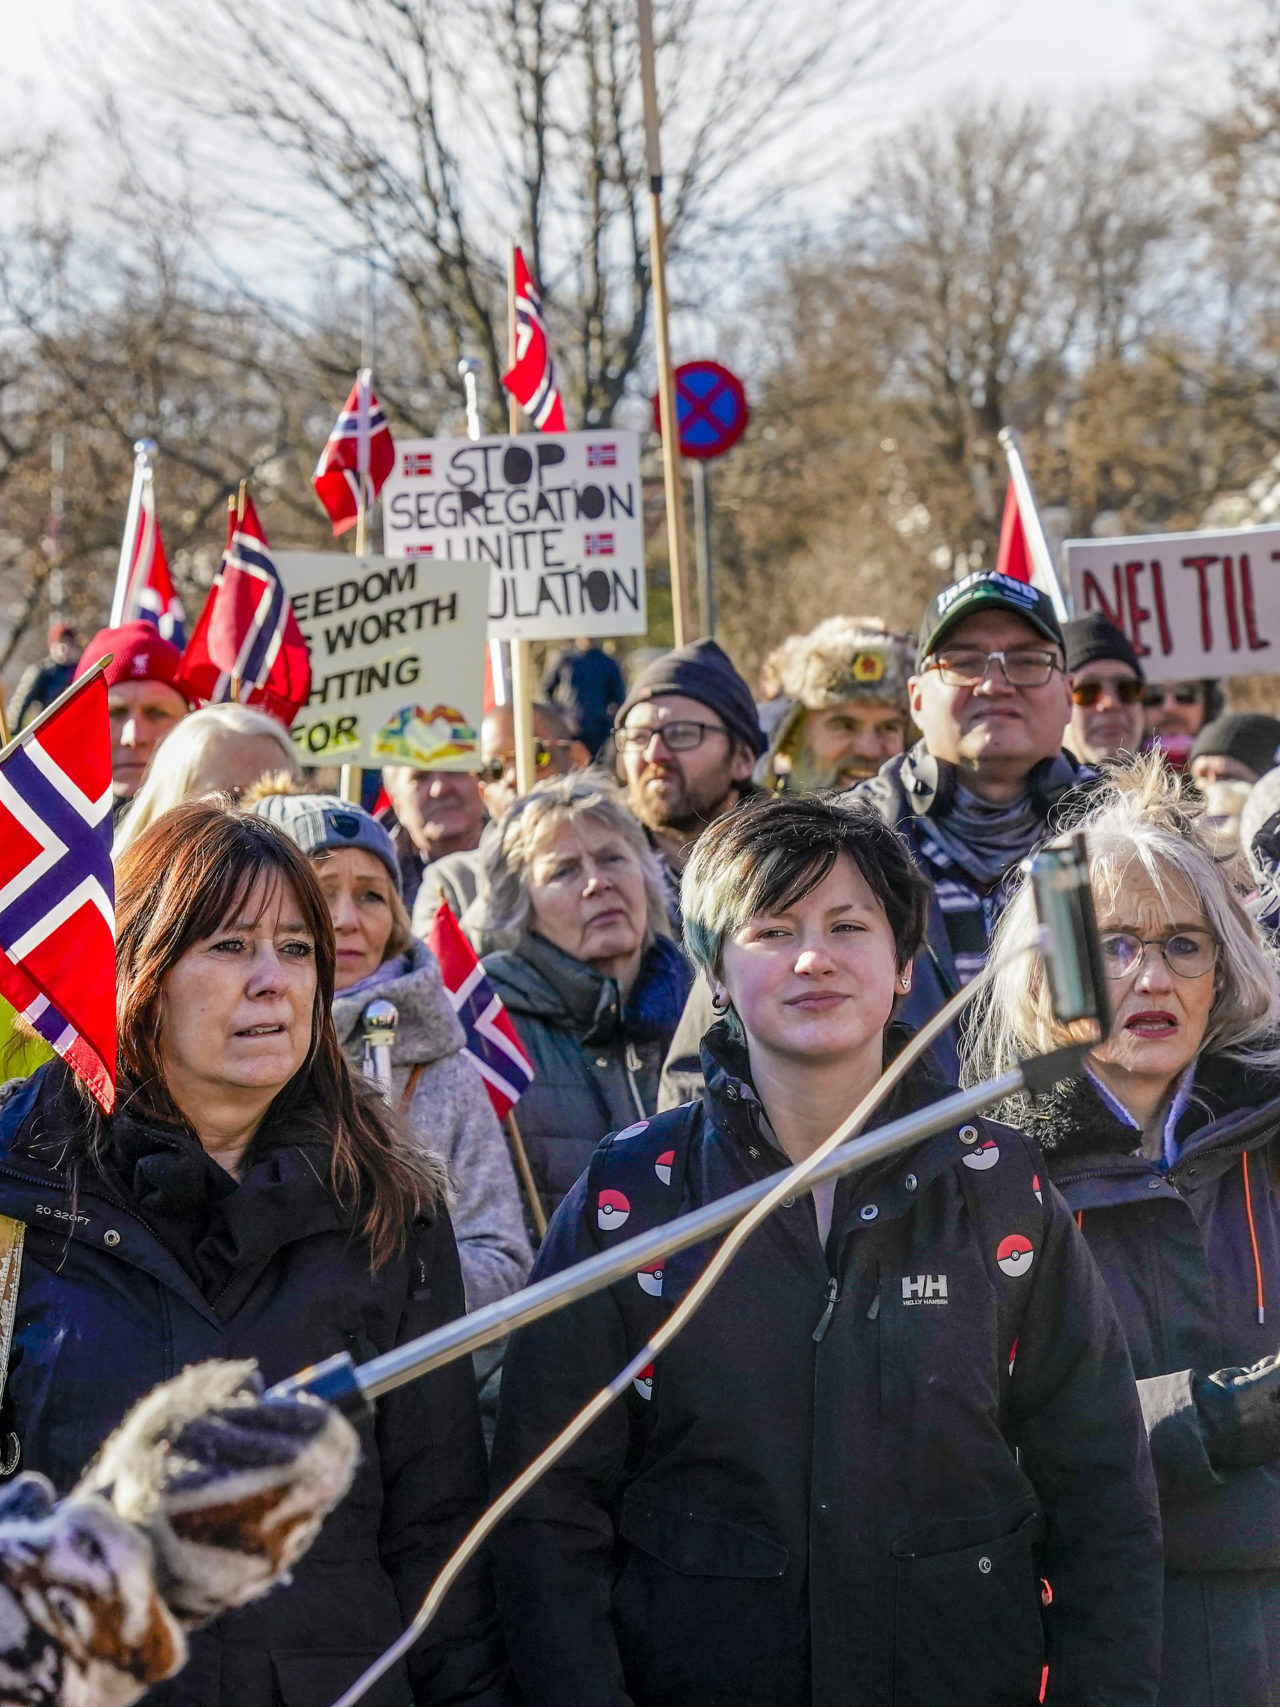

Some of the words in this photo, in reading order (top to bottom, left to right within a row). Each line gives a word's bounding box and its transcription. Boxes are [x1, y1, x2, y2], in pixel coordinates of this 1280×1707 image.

[446, 443, 566, 492] STOP
[390, 481, 634, 530] SEGREGATION
[291, 562, 417, 622] EEDOM
[1082, 560, 1174, 657] NEI
[1181, 553, 1270, 653] TIL
[323, 592, 458, 655] WORTH
[304, 656, 420, 706] HTING
[35, 1204, 52, 1215] 20
[901, 1274, 948, 1298] HH
